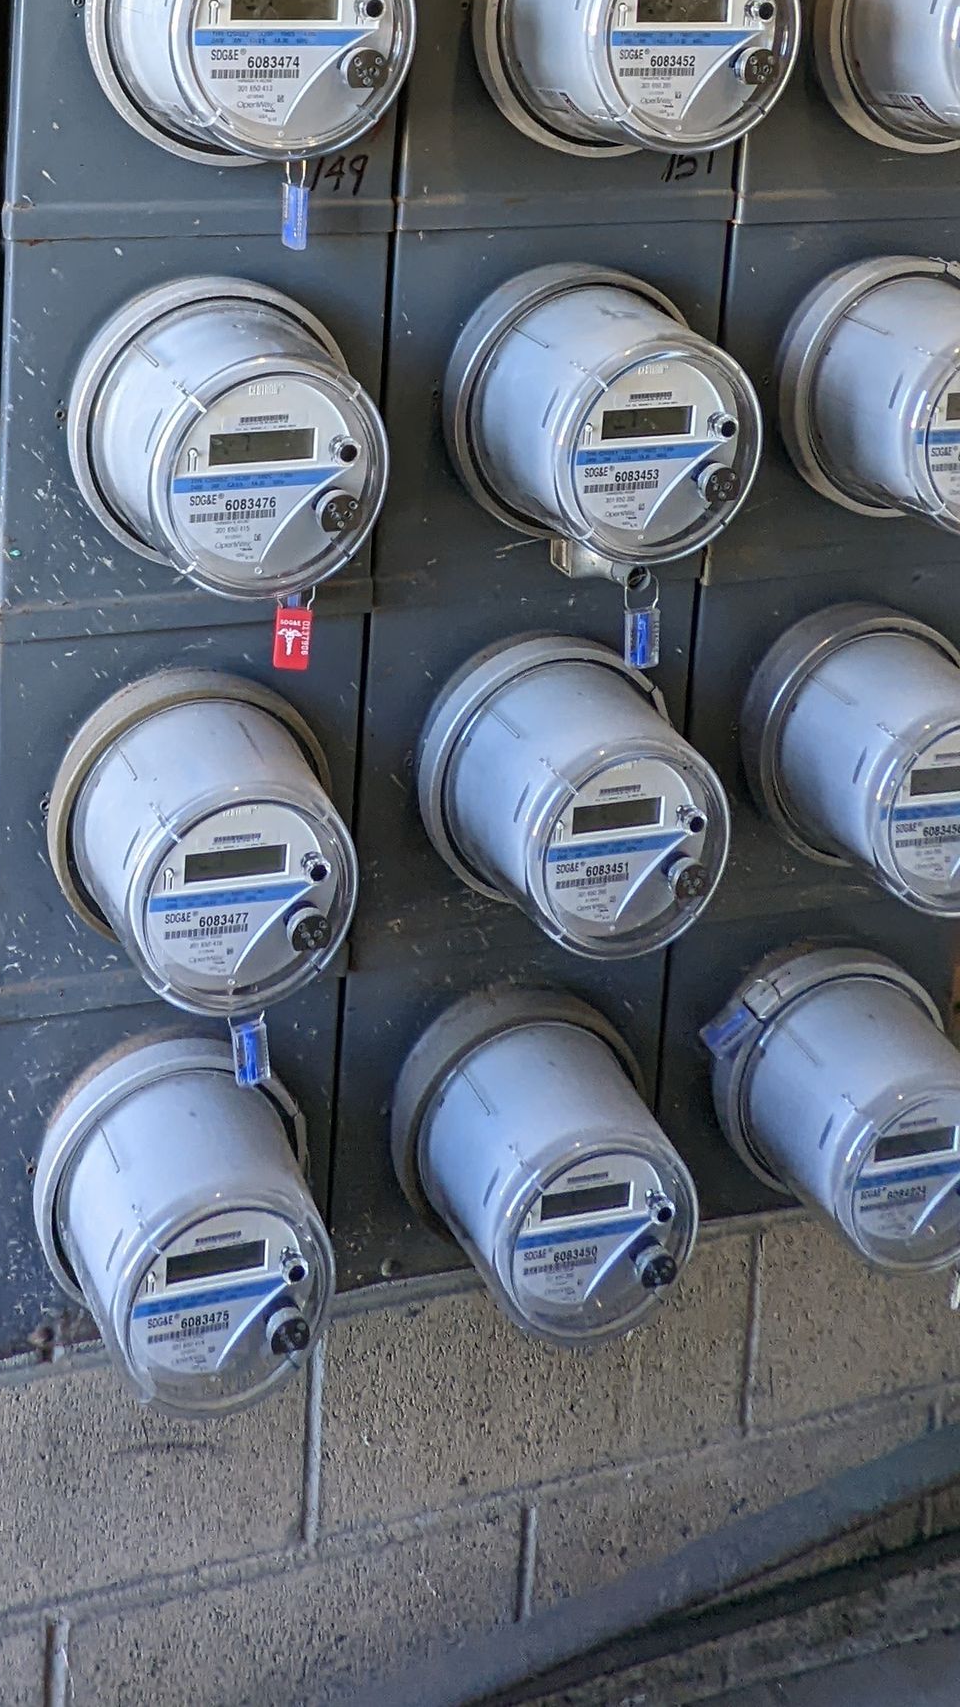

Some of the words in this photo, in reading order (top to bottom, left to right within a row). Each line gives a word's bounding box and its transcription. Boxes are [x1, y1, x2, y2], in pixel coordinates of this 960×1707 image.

[210, 49, 239, 60] SDG&E
[247, 56, 300, 68] 6083474
[650, 55, 696, 67] 6083452
[310, 154, 368, 196] 149
[584, 466, 609, 478] SDG&E
[615, 469, 659, 482] 6083453
[189, 494, 218, 506] SDG&E
[225, 496, 277, 511] 6083476
[586, 861, 629, 877] 6083451
[164, 912, 191, 924] SDG&E
[199, 912, 249, 927] 6083477
[181, 1310, 229, 1329] 6083475
